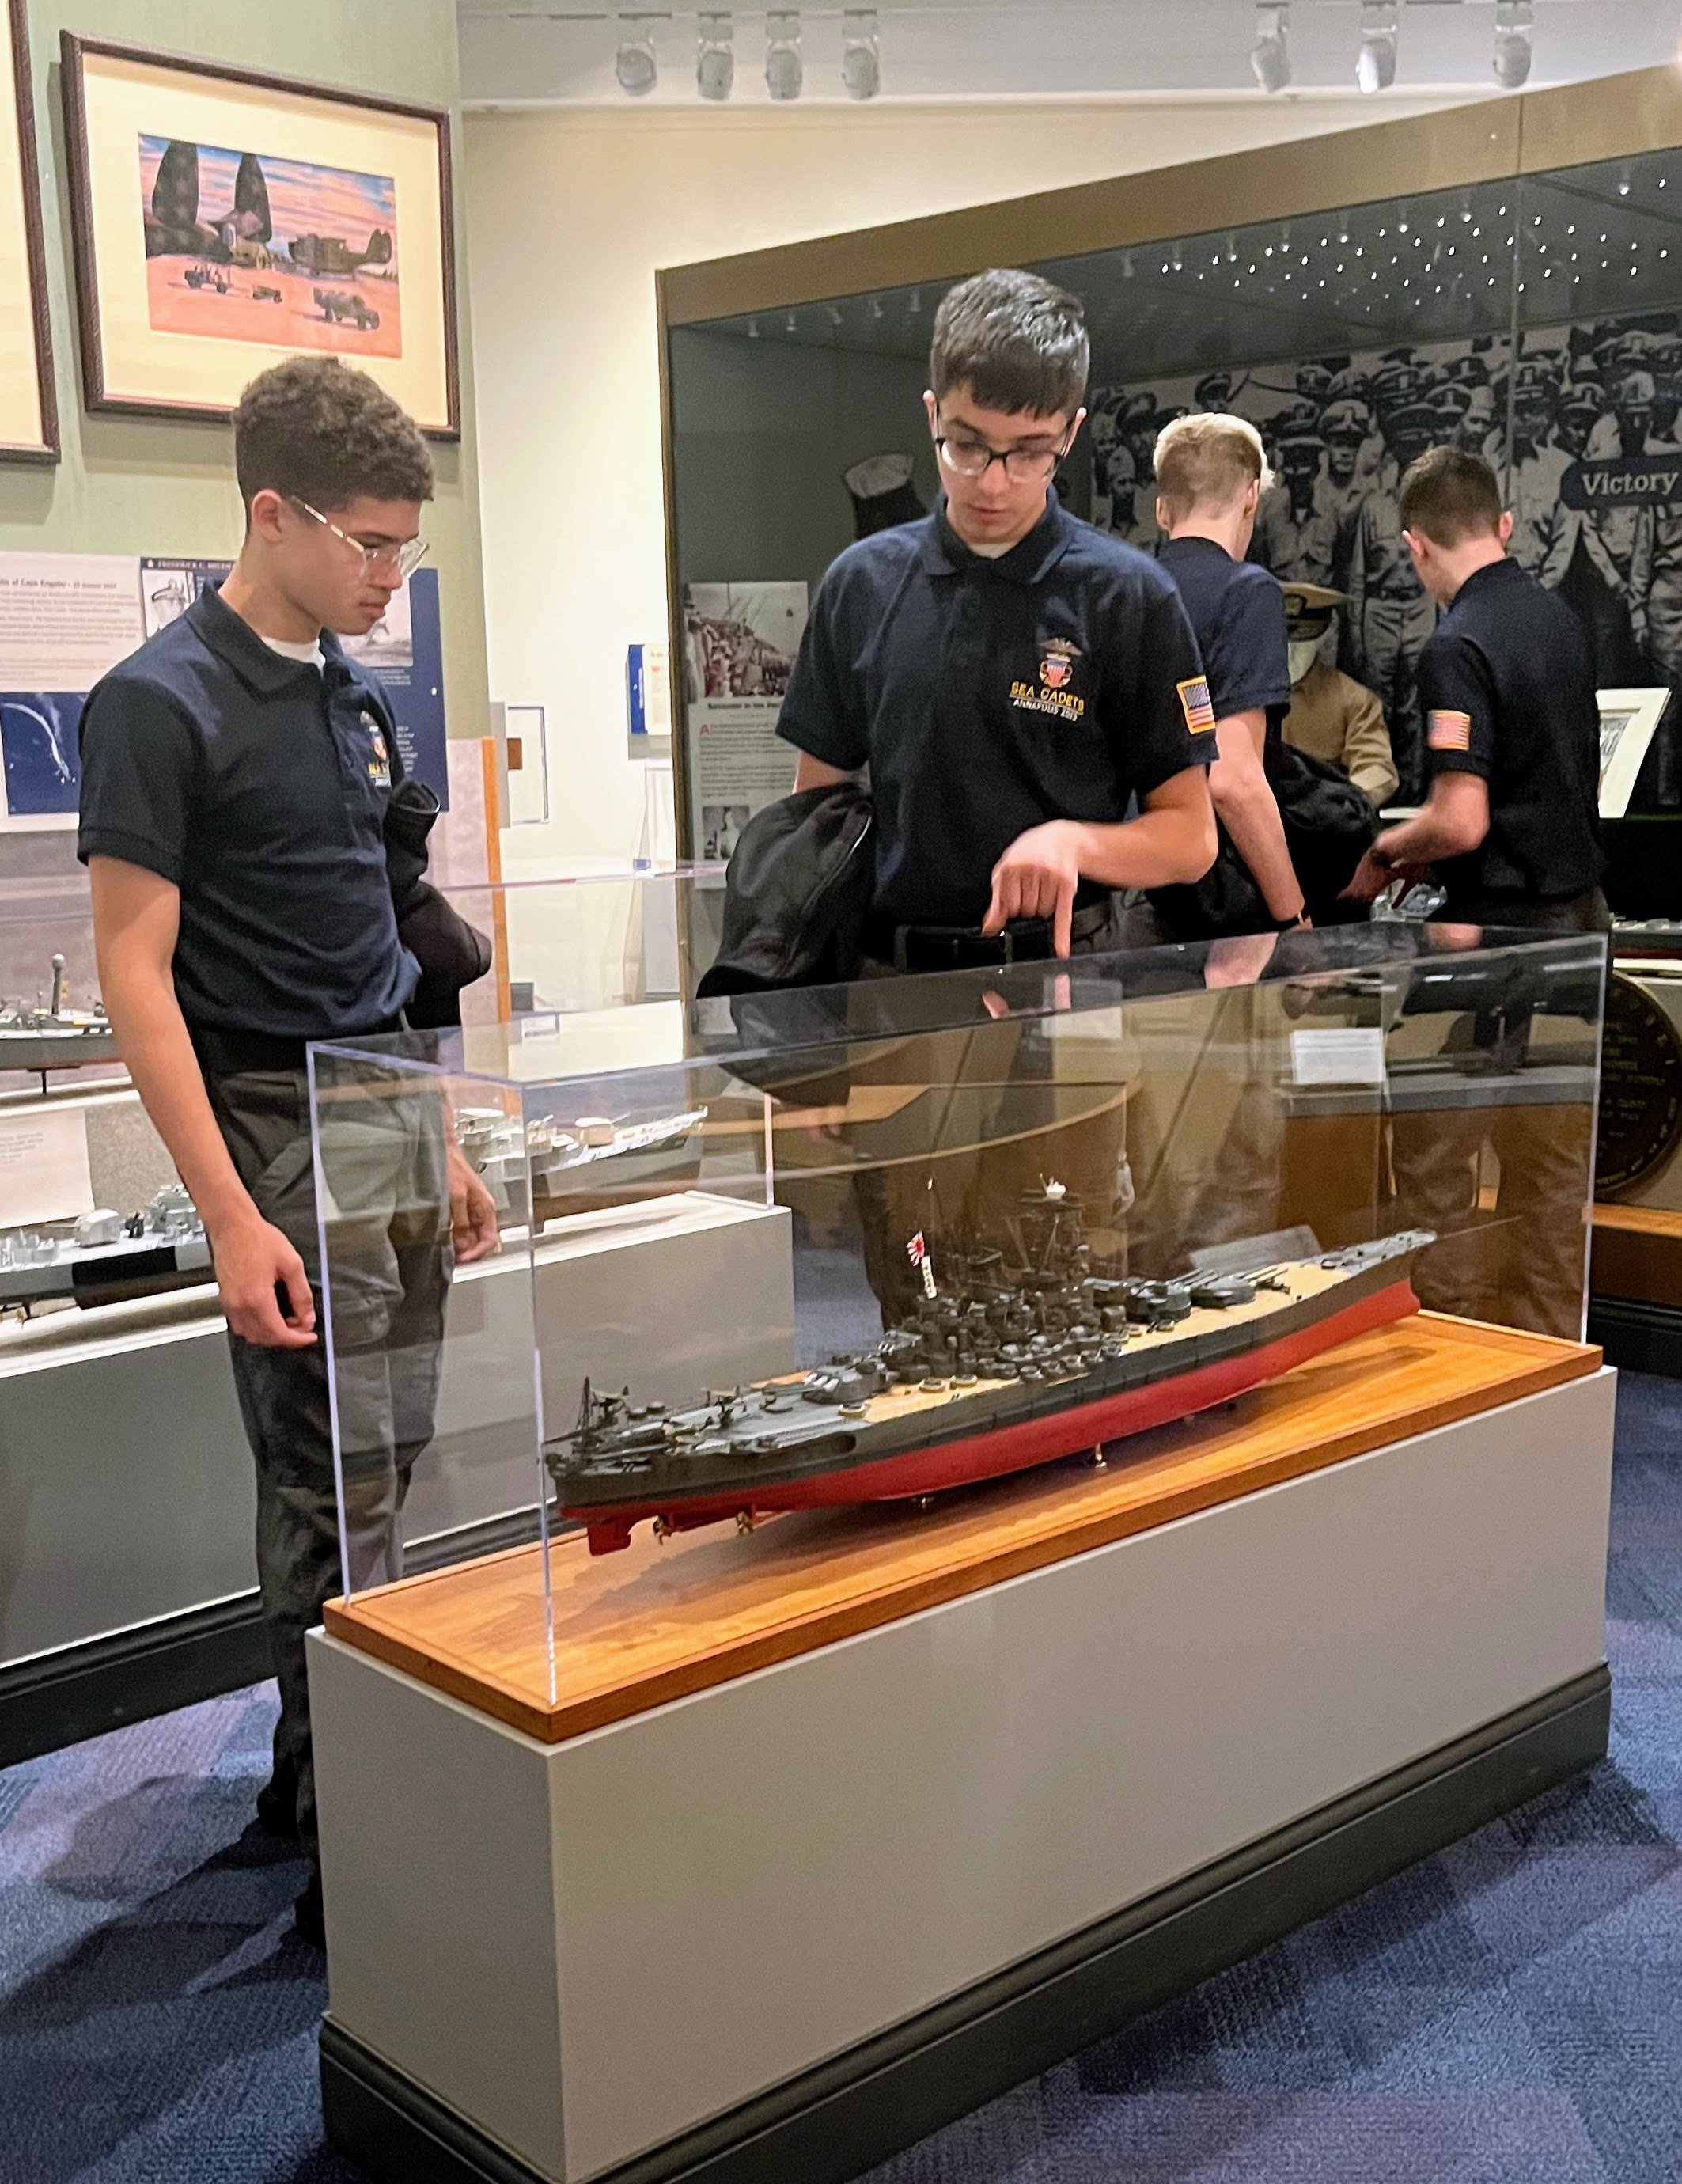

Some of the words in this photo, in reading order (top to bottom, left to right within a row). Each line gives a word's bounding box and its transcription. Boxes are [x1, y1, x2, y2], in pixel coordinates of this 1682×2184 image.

[1582, 471, 1679, 496] Victory
[1011, 681, 1035, 698] SEA
[1040, 686, 1085, 713] CADETS
[1013, 699, 1059, 715] ANNAPOLIS
